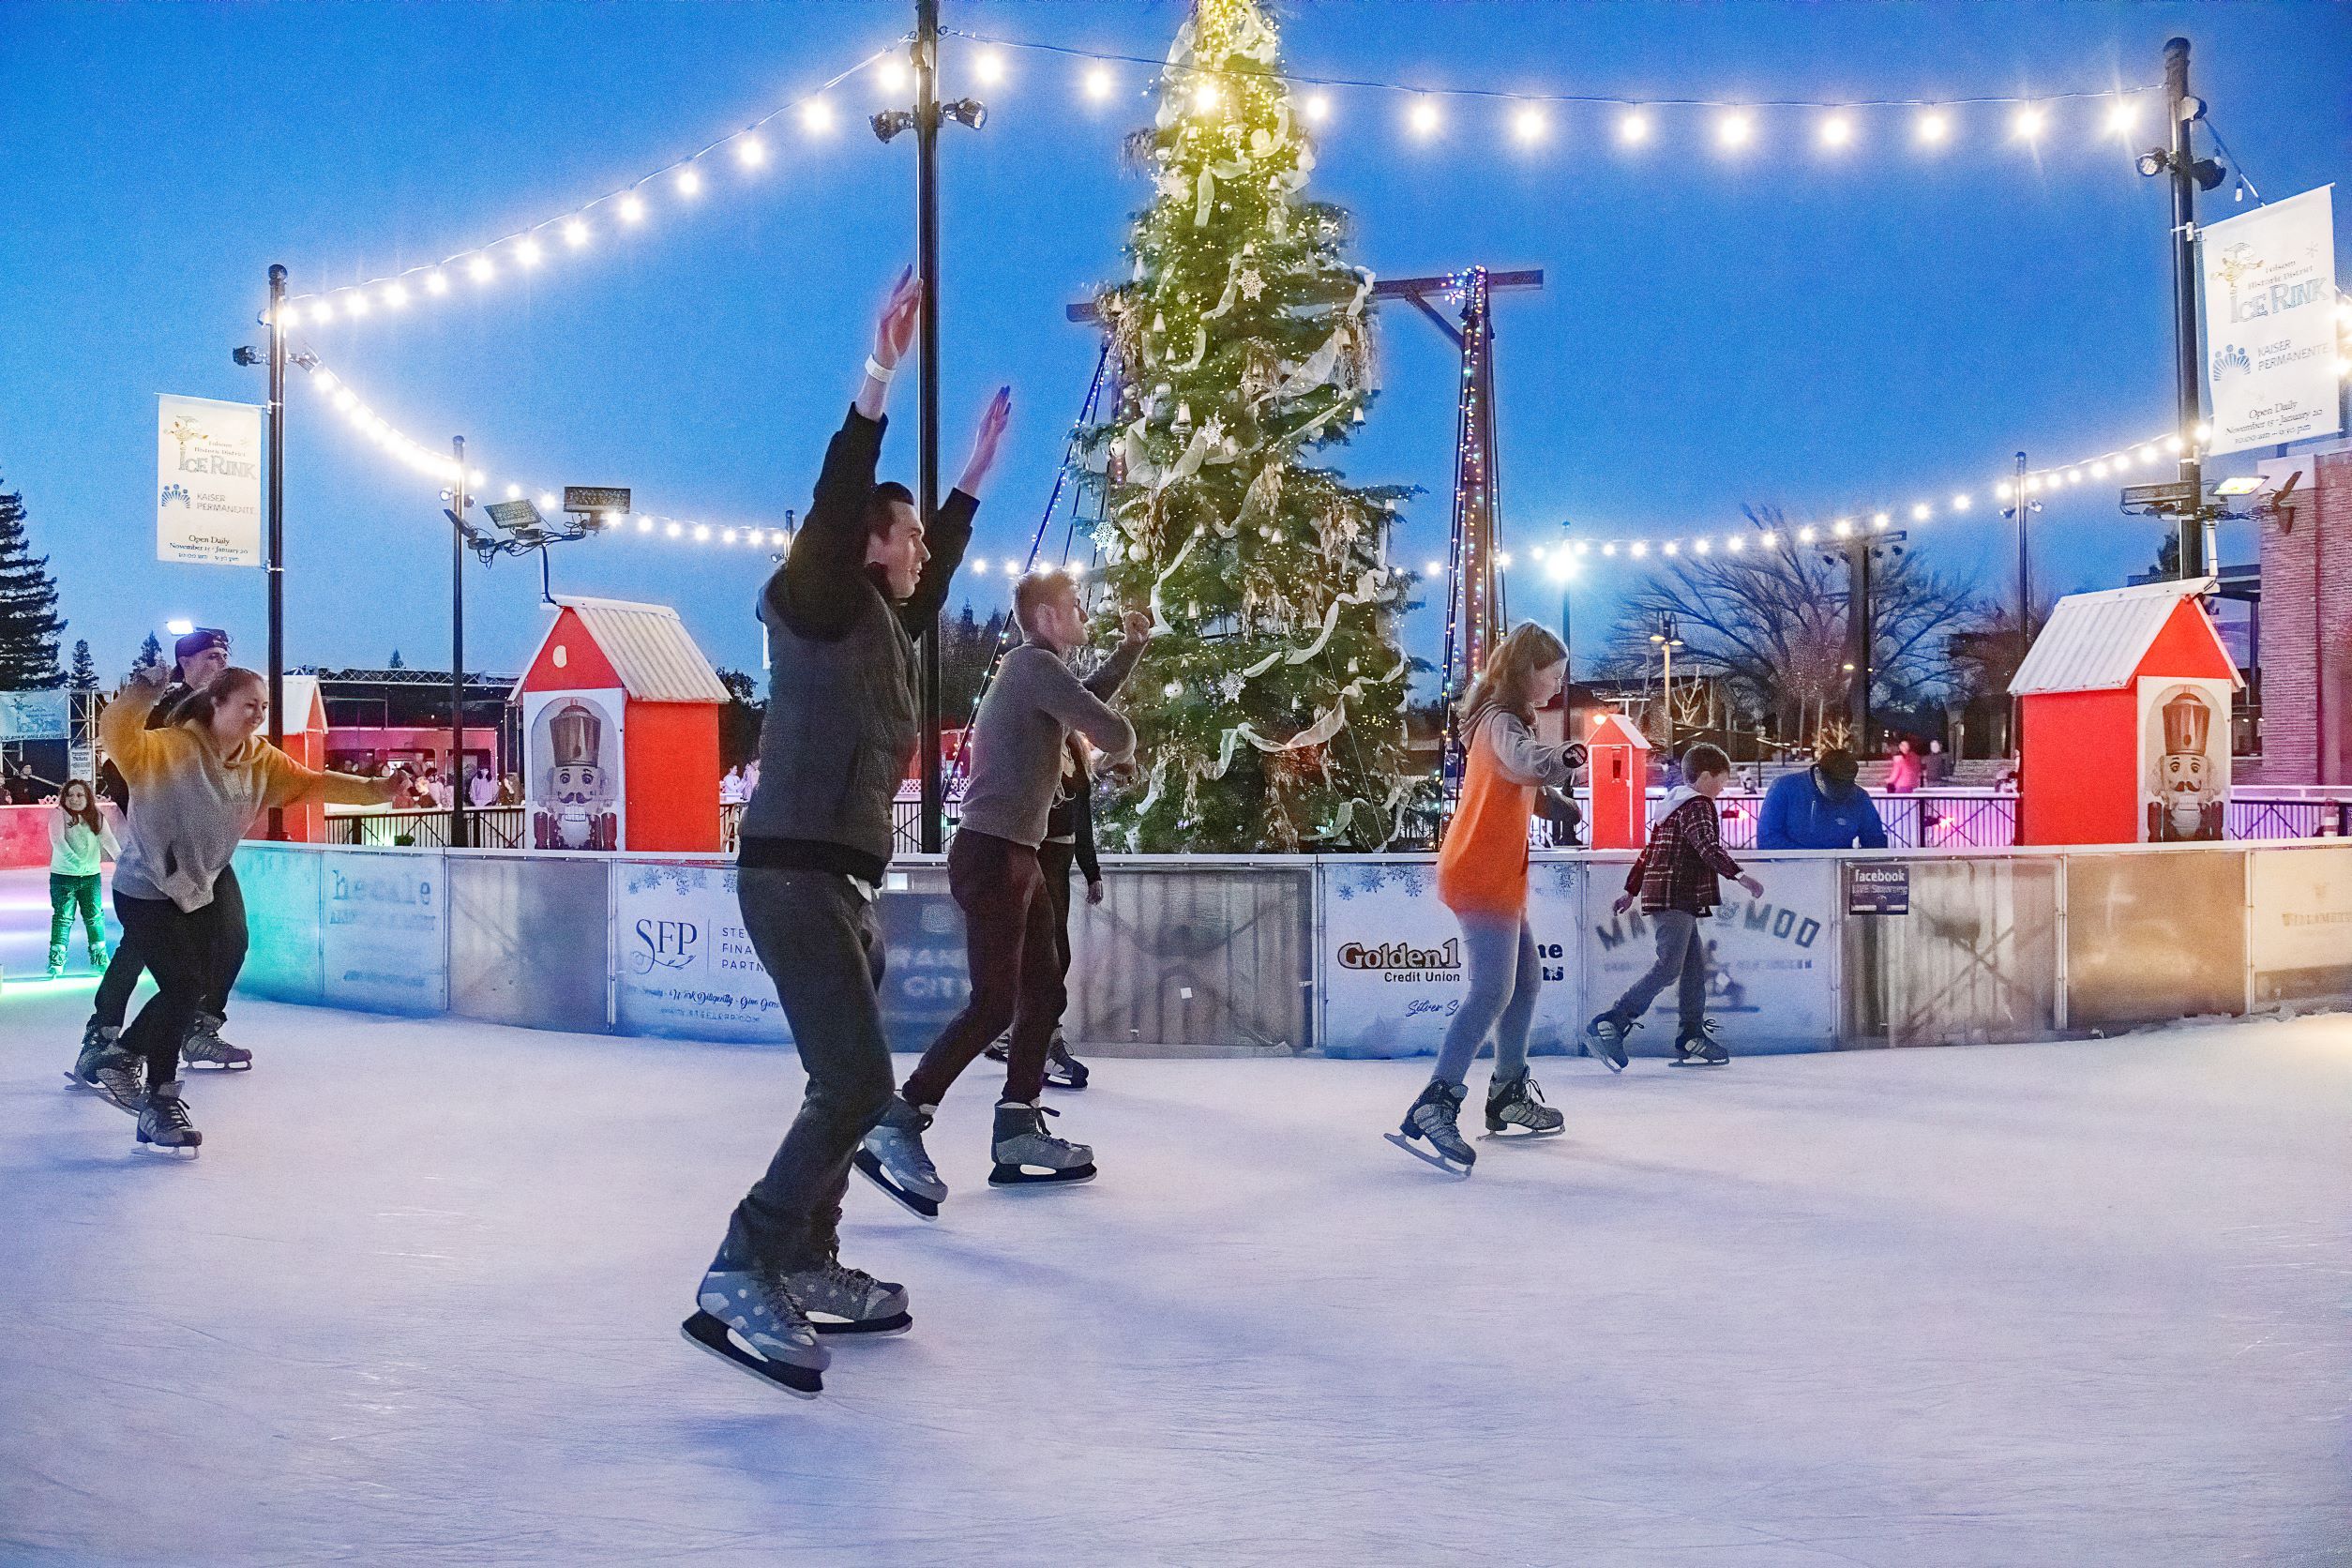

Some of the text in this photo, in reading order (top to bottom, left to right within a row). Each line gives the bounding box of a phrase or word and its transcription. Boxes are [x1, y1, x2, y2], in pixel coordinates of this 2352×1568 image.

[2269, 277, 2329, 314] RINK
[2257, 339, 2292, 356] KAISER
[2257, 341, 2329, 371] PERMANENTE
[2249, 400, 2299, 420] Open Daily
[2225, 421, 2265, 435] November
[2279, 411, 2311, 426] January
[211, 455, 257, 480] RINK
[196, 493, 226, 502] KAISER
[196, 502, 257, 515] PERMANENTE
[188, 535, 230, 546] Open Daily
[170, 542, 203, 551] November
[215, 546, 239, 554] January
[1855, 868, 1906, 882] facebook
[722, 927, 749, 939] STE
[722, 943, 753, 955] FINA
[721, 959, 765, 972] PARTN
[1384, 971, 1460, 983] Credit Union
[1406, 999, 1444, 1018] Silver
